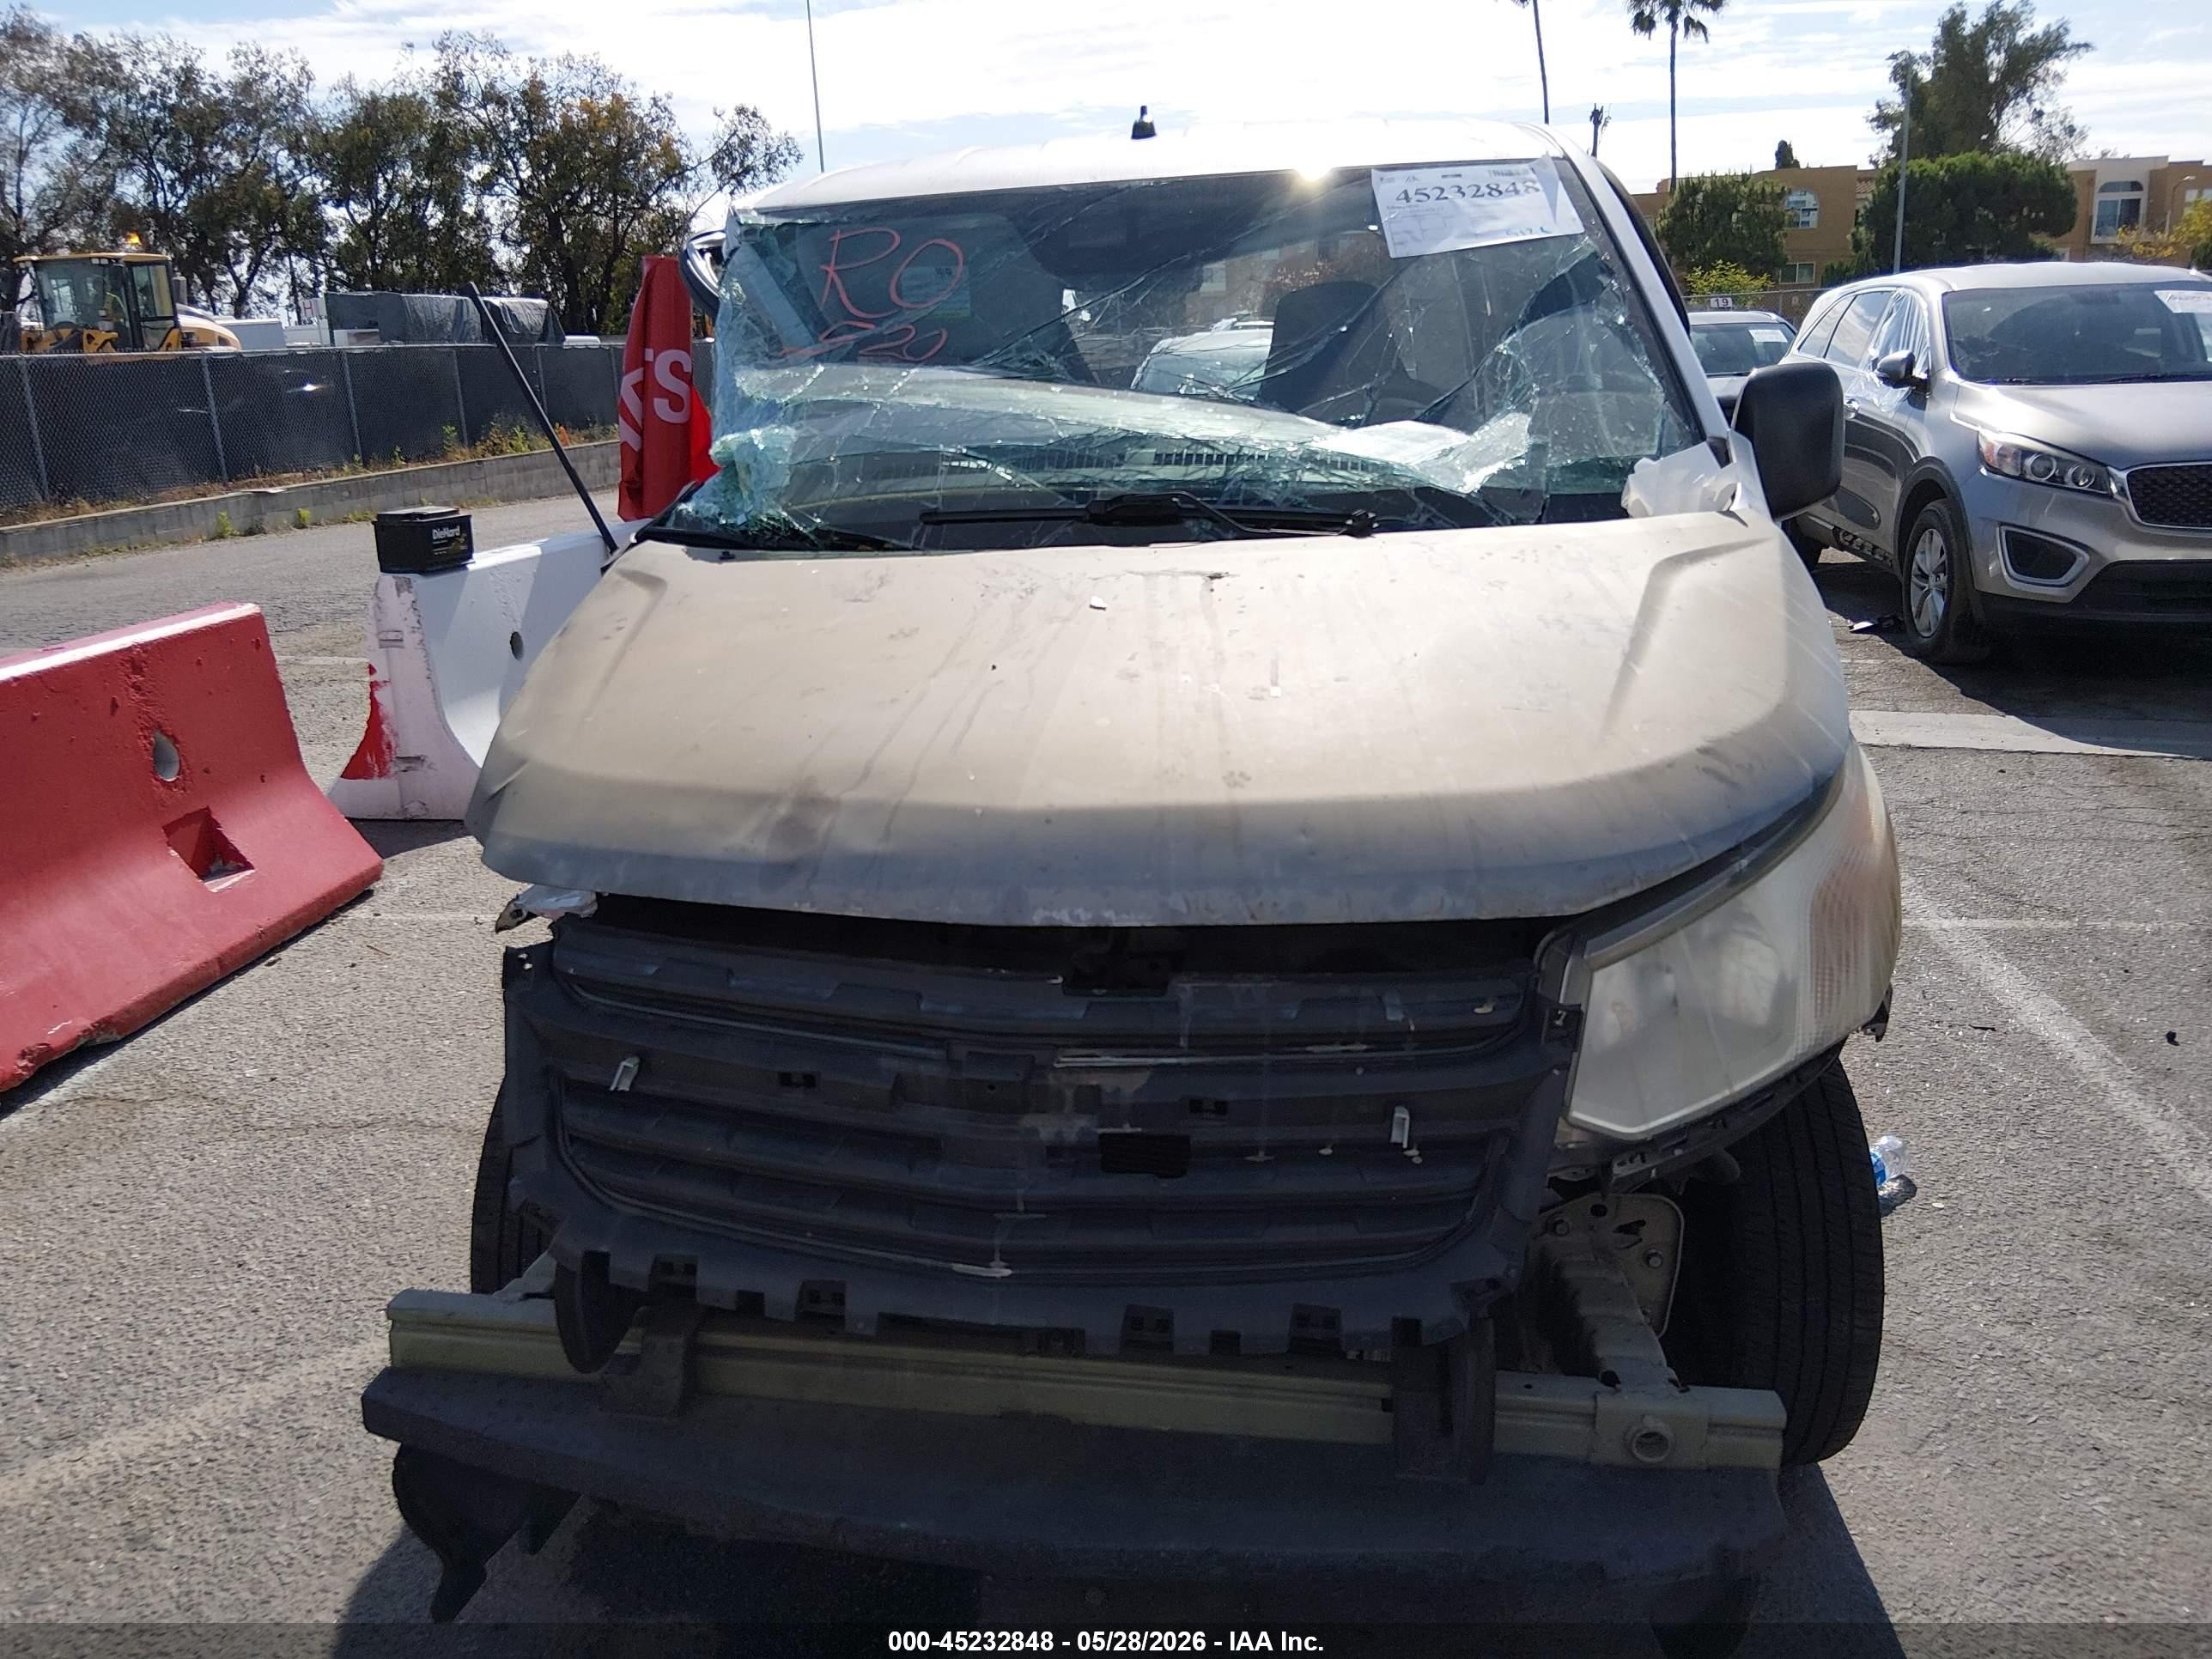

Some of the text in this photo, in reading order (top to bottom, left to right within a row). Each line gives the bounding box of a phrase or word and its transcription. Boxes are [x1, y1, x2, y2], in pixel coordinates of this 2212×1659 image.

[1395, 179, 1541, 204] 45232848
[819, 226, 965, 319] RO
[1714, 297, 1729, 307] 19
[432, 525, 461, 540] DieHard
